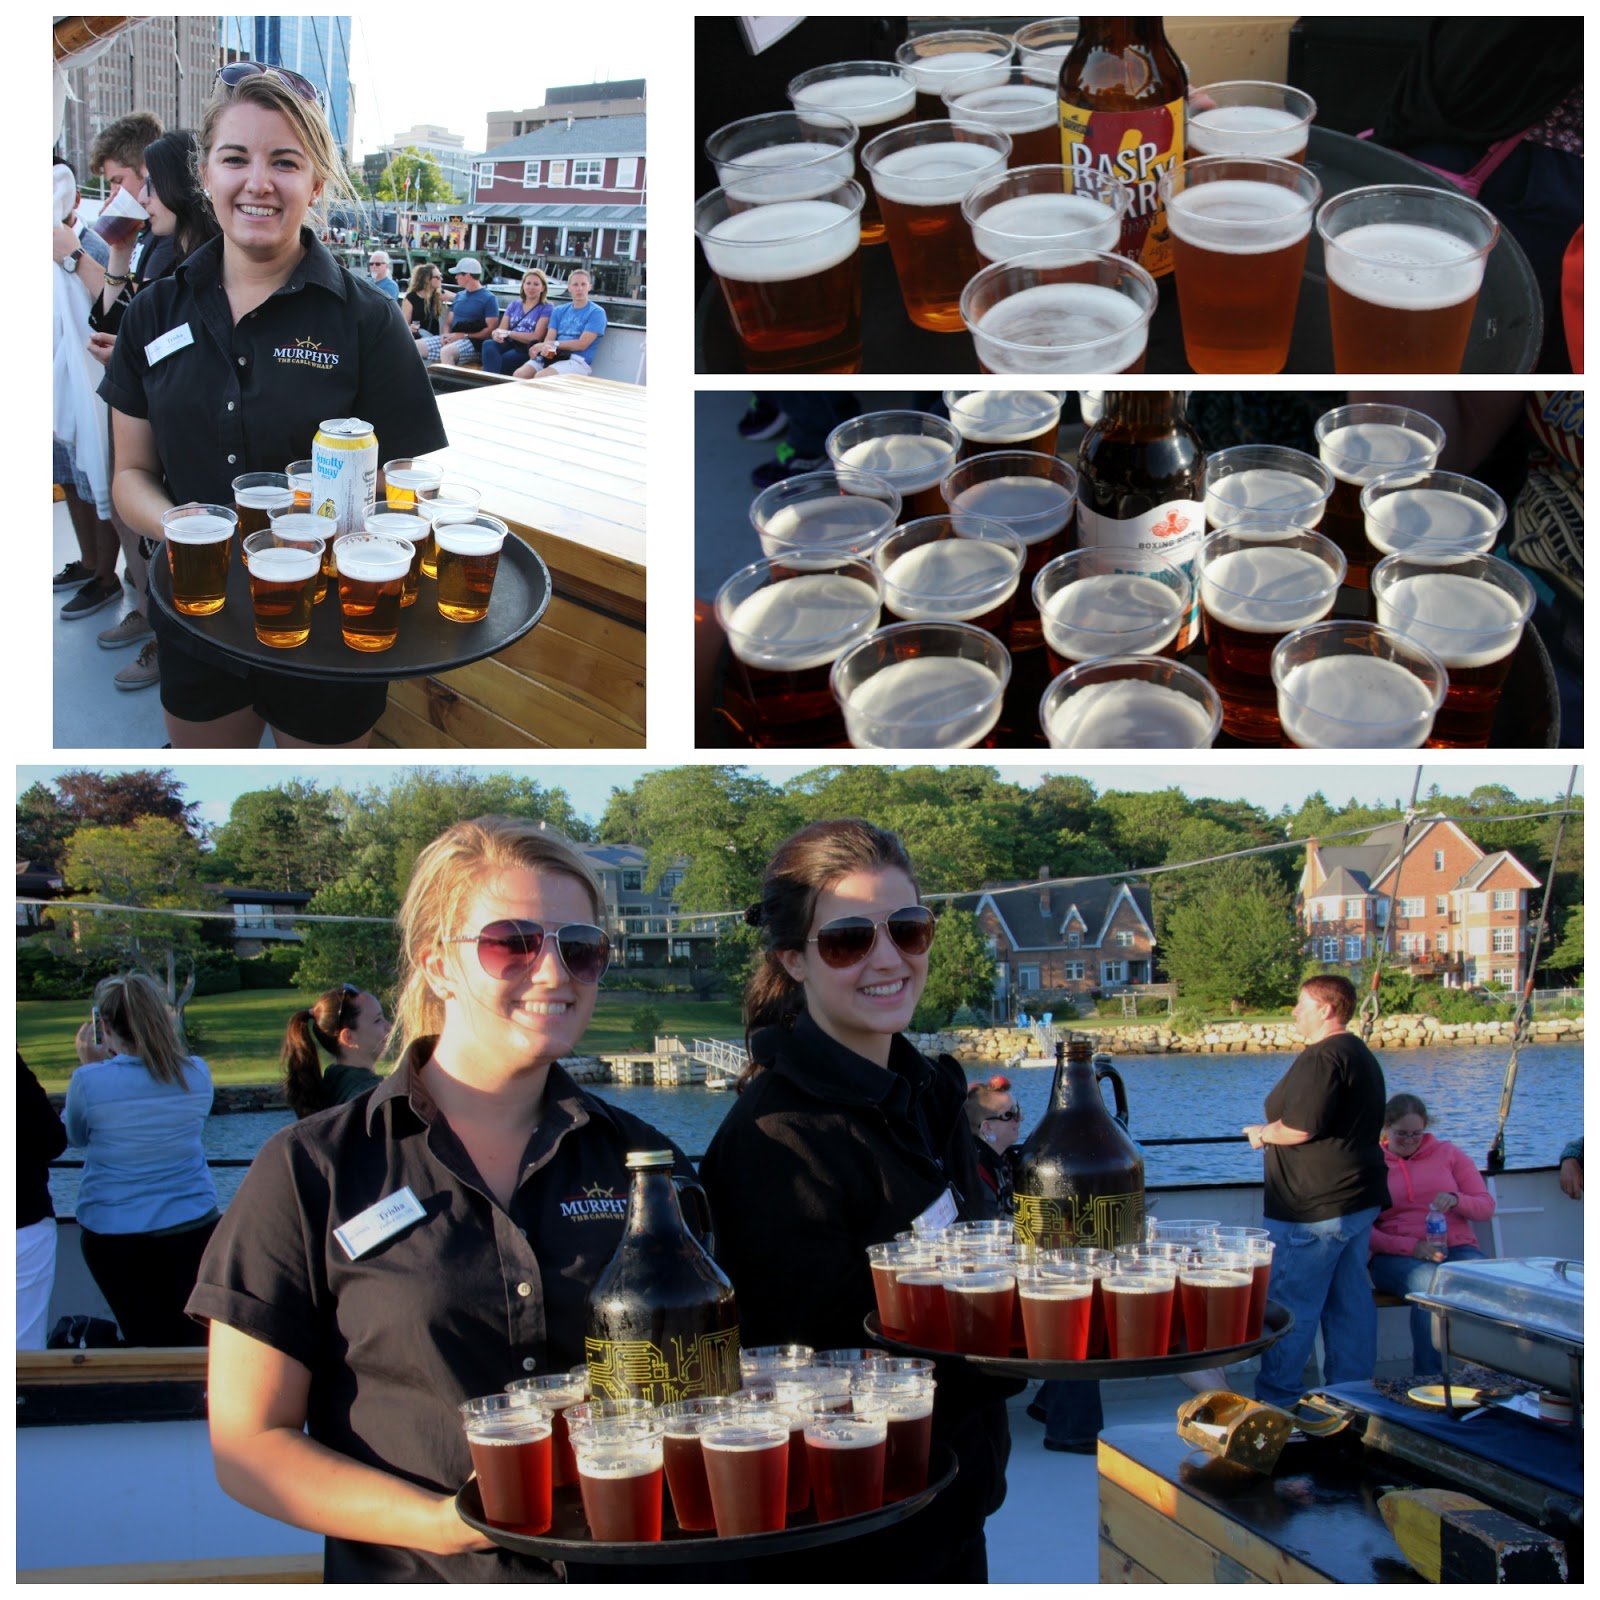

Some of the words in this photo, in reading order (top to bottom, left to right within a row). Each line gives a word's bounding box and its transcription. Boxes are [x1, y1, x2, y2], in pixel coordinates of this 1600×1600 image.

[1071, 142, 1158, 190] RASP
[273, 347, 339, 365] MURPHY'S
[292, 358, 311, 366] CABLE
[311, 362, 333, 370] WHARF
[316, 452, 344, 471] knotty
[317, 463, 339, 480] buoy
[1138, 540, 1176, 549] BOXING
[377, 1203, 405, 1221] Trisha
[570, 1214, 589, 1222] THE
